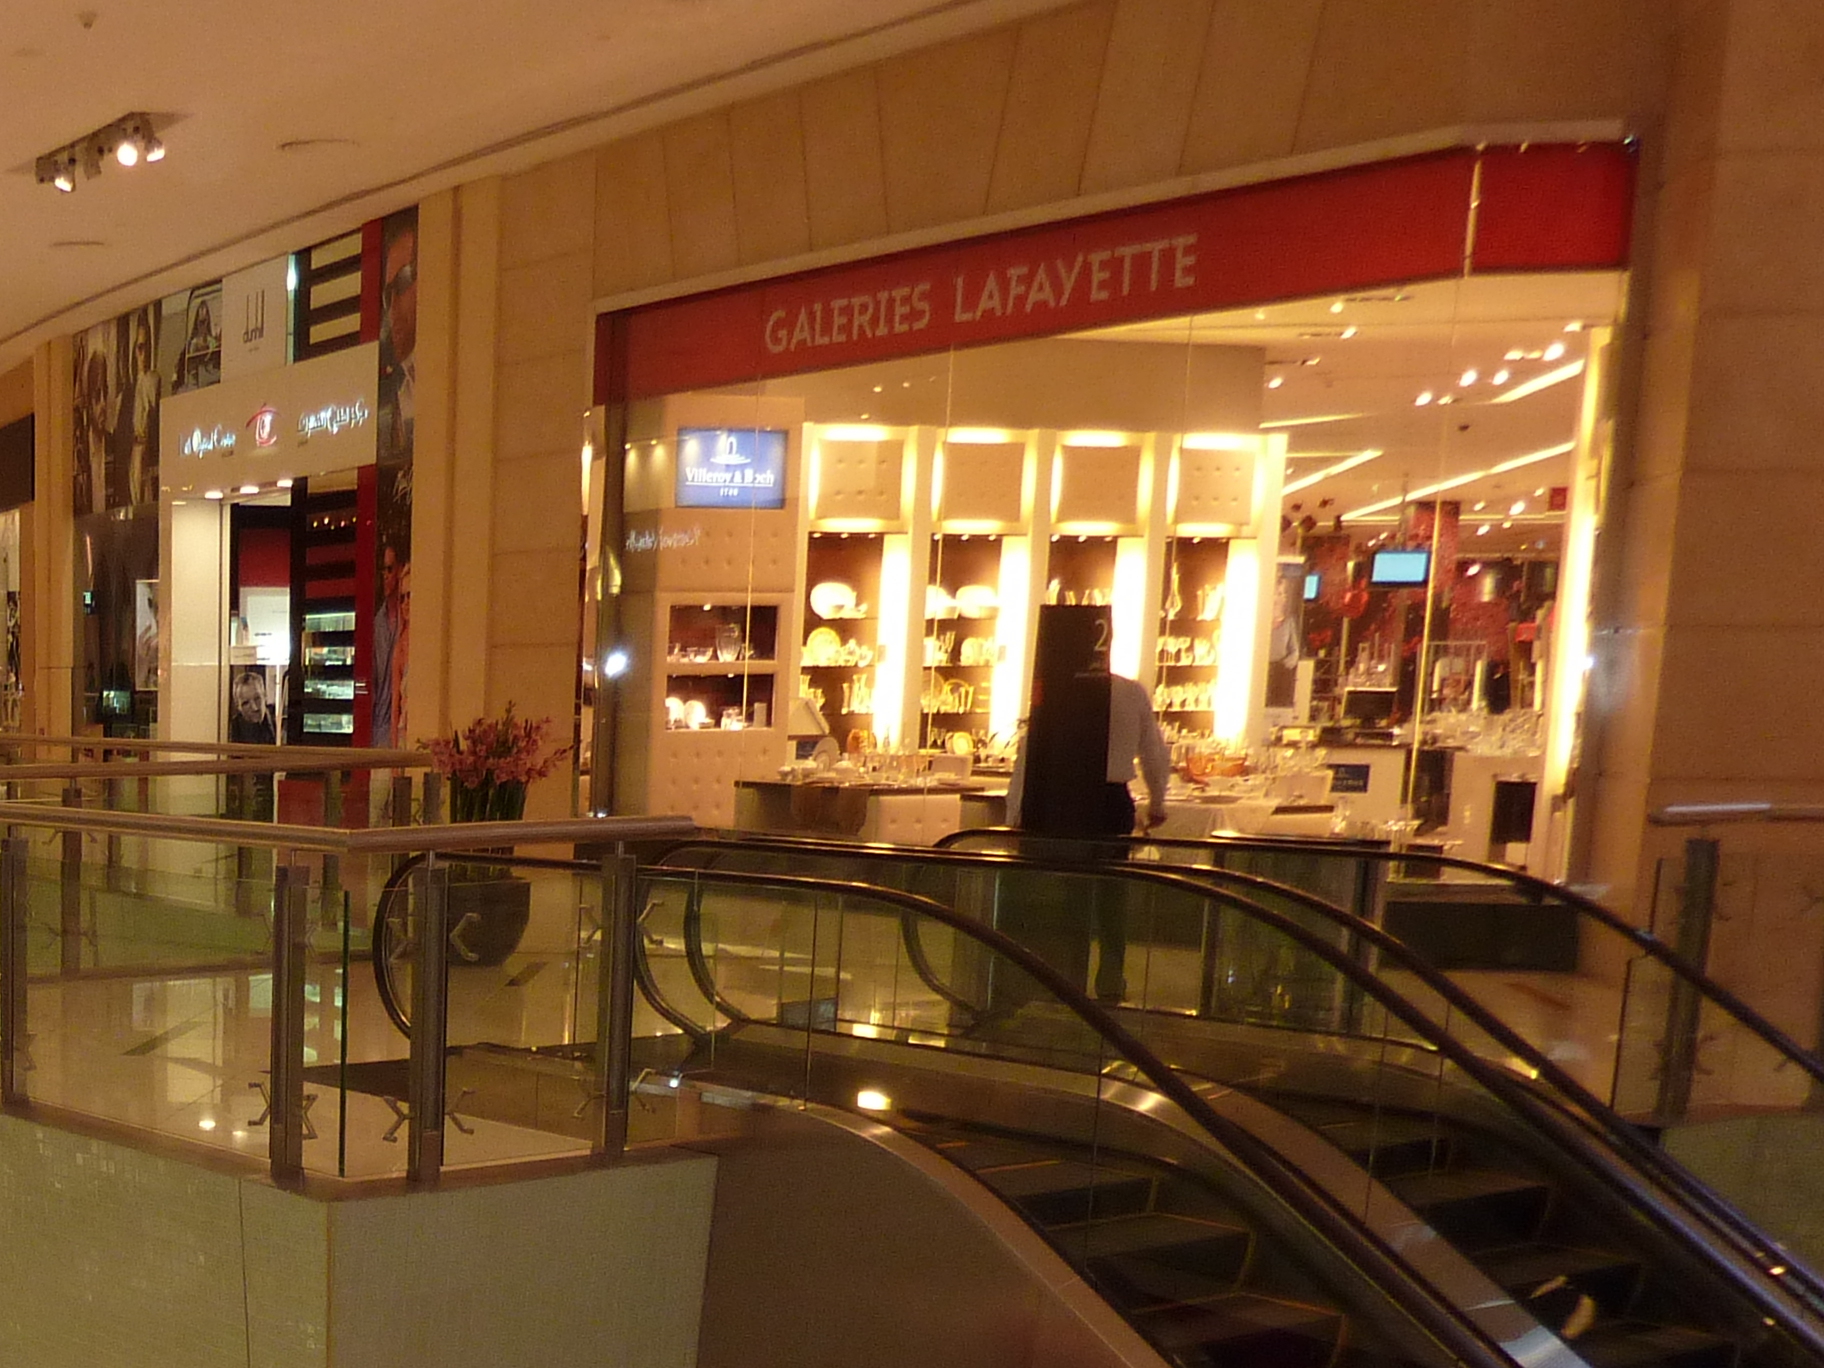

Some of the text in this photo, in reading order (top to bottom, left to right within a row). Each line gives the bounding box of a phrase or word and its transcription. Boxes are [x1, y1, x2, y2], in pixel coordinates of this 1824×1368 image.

[764, 233, 1198, 354] GALERIES LAFAYETTE
[685, 467, 733, 485] Villeroy
[1094, 619, 1107, 651] 2
